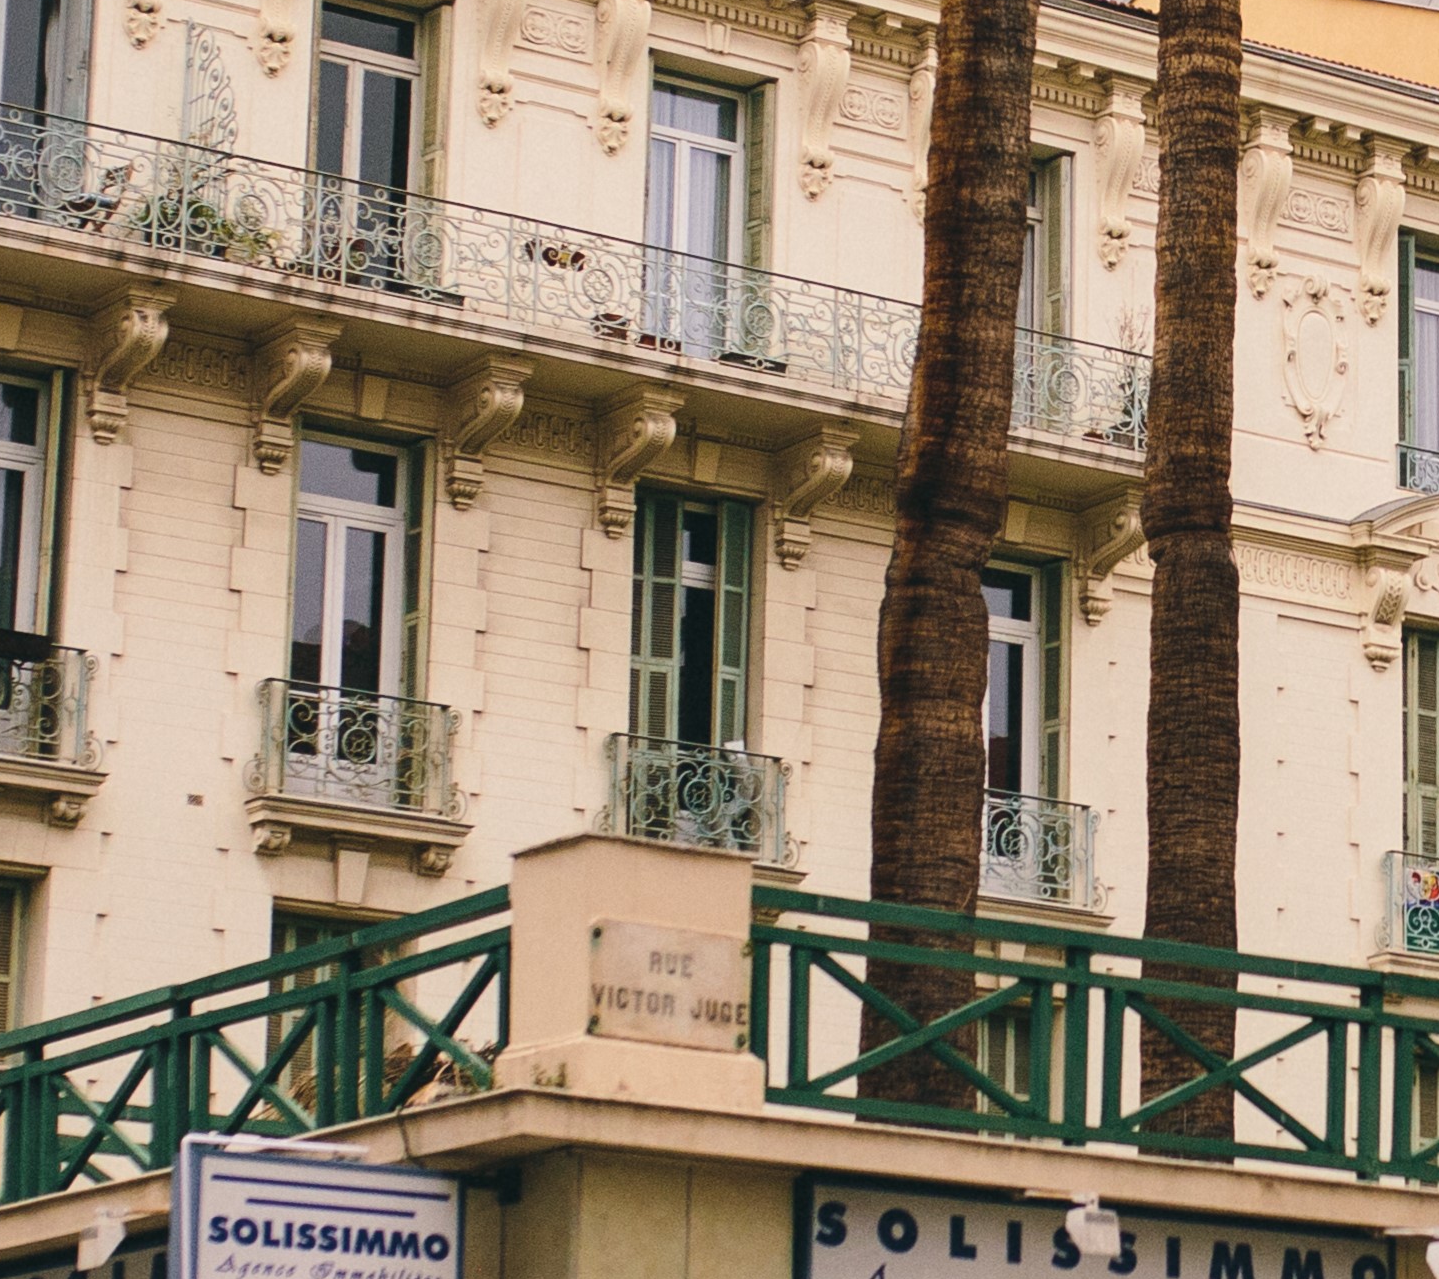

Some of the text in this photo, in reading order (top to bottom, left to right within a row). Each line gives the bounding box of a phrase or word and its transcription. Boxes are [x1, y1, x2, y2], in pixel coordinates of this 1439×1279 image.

[649, 950, 693, 980] RUE
[590, 983, 675, 1017] VICTOR
[208, 1215, 450, 1261] SOLISSIMMO
